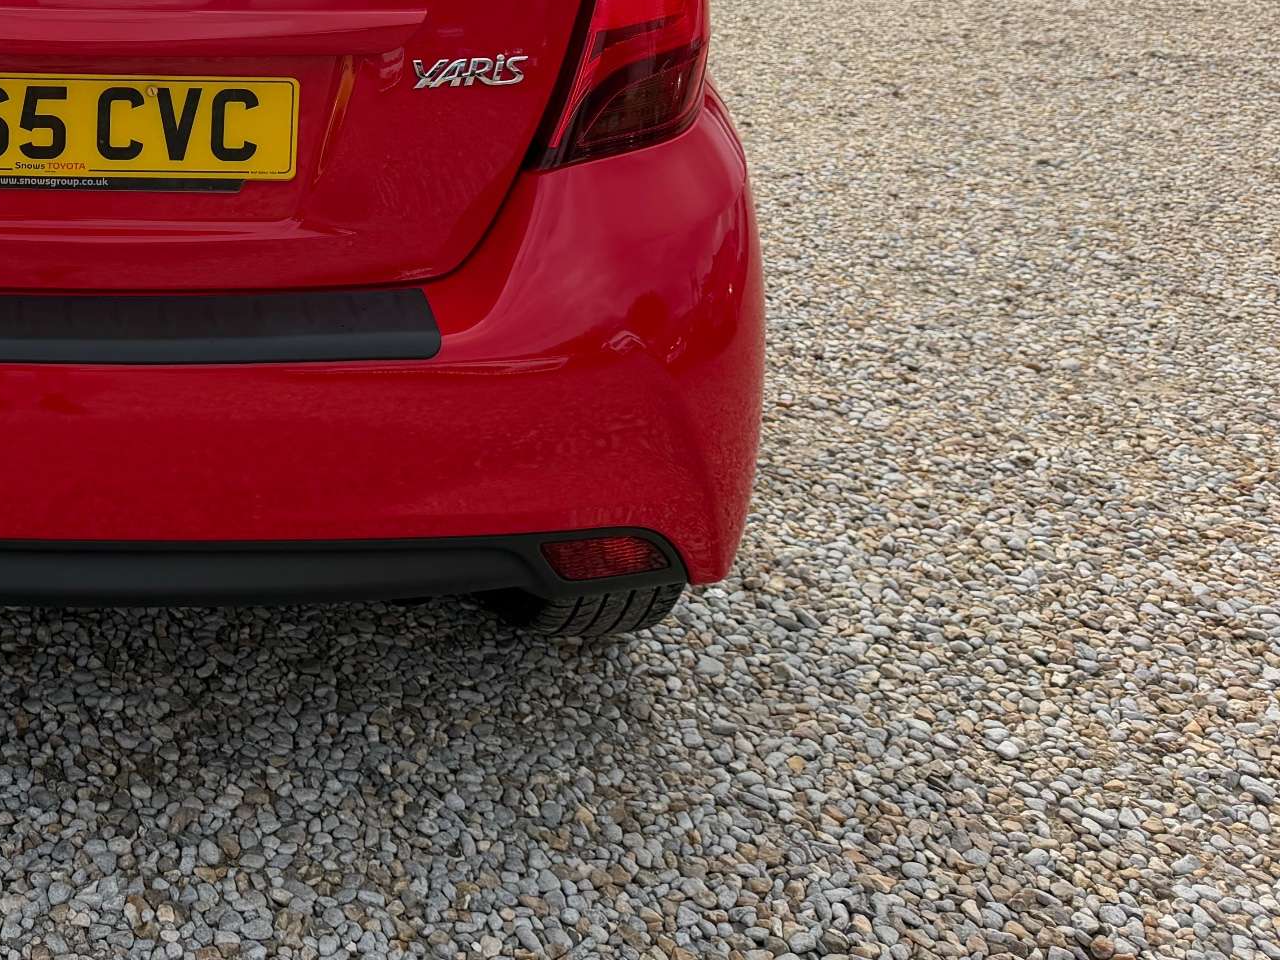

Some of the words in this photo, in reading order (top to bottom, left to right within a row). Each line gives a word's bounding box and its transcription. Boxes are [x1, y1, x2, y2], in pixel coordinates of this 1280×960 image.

[96, 86, 260, 162] CVC
[15, 161, 46, 170] Snows
[46, 162, 86, 170] TOYOTA
